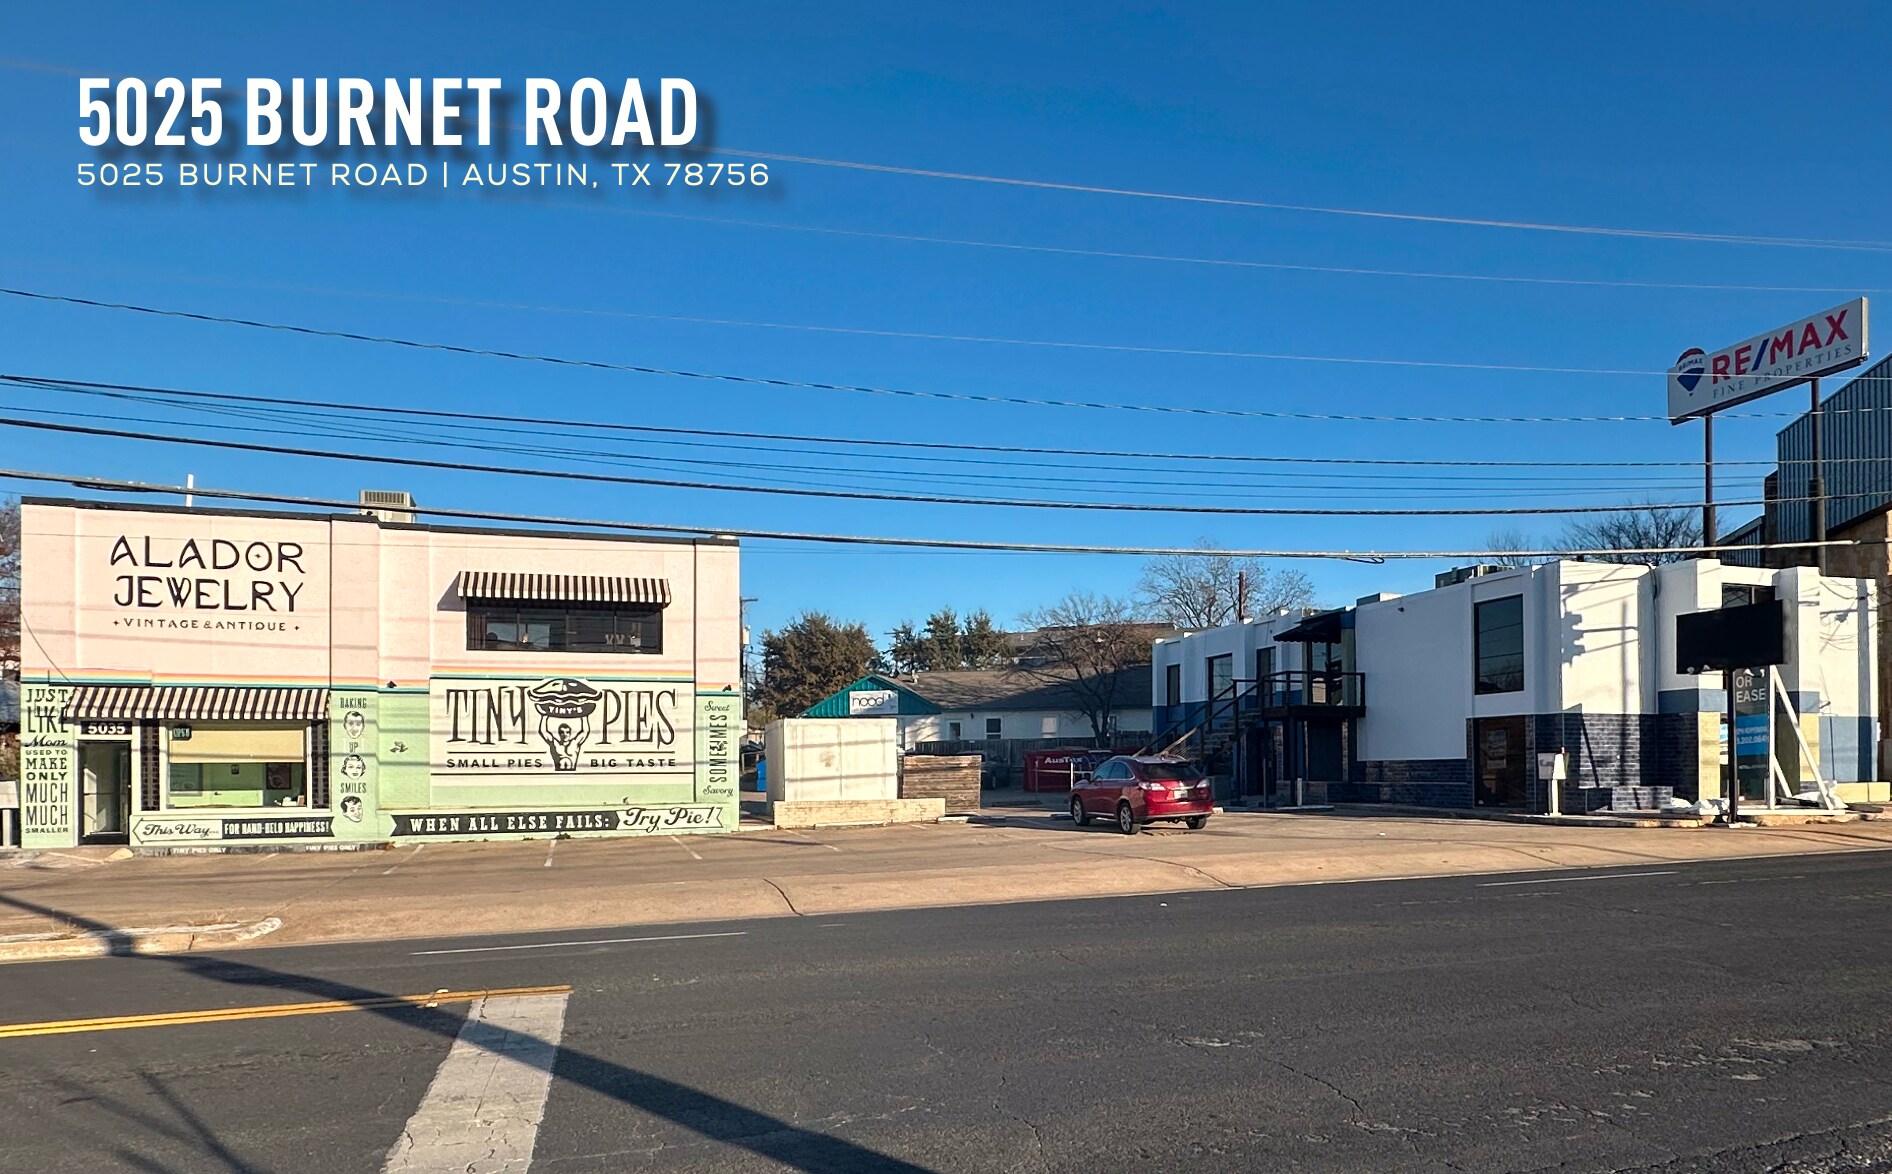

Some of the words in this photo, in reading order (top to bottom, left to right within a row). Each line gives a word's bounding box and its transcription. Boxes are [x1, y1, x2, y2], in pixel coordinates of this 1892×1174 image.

[1712, 309, 1849, 385] RE/MAX
[1712, 380, 1745, 400] FINE
[1754, 344, 1853, 385] PROPERTIES
[110, 535, 306, 574] ALADOR
[114, 575, 304, 612] JEWELRY
[123, 618, 199, 629] VINTAGE
[215, 621, 286, 631] ANTIQUE
[1736, 676, 1752, 688] OR
[26, 688, 69, 703] JUST
[1736, 688, 1766, 703] EASE
[340, 697, 367, 708] BAKING
[704, 700, 730, 711] Sweet
[548, 706, 583, 715] TINY'S
[27, 705, 69, 733] LIKE
[446, 686, 531, 745] TINY
[595, 688, 677, 749] PIES
[87, 722, 126, 734] 5035
[25, 735, 67, 747] Mom
[348, 742, 359, 753] UP
[25, 757, 67, 770] MAKE
[446, 758, 500, 768] SMALL
[507, 758, 543, 768] PIES
[590, 758, 618, 768] BIG
[627, 758, 676, 767] TASTE
[26, 772, 68, 781] ONLY
[26, 782, 68, 803] MUCH
[340, 782, 367, 794] SMILES
[703, 785, 734, 797] Savory
[26, 805, 68, 825] MUCH
[410, 818, 460, 832] WHEN
[469, 817, 499, 831] ALL
[507, 815, 548, 830] ELSE
[556, 814, 610, 828] FAILS:
[623, 807, 662, 833] Try
[664, 806, 716, 826] Pie!
[142, 824, 173, 836] This
[224, 823, 240, 834] FOR
[241, 822, 283, 834] HAND-HELD
[284, 821, 329, 833] HAPPINESS!
